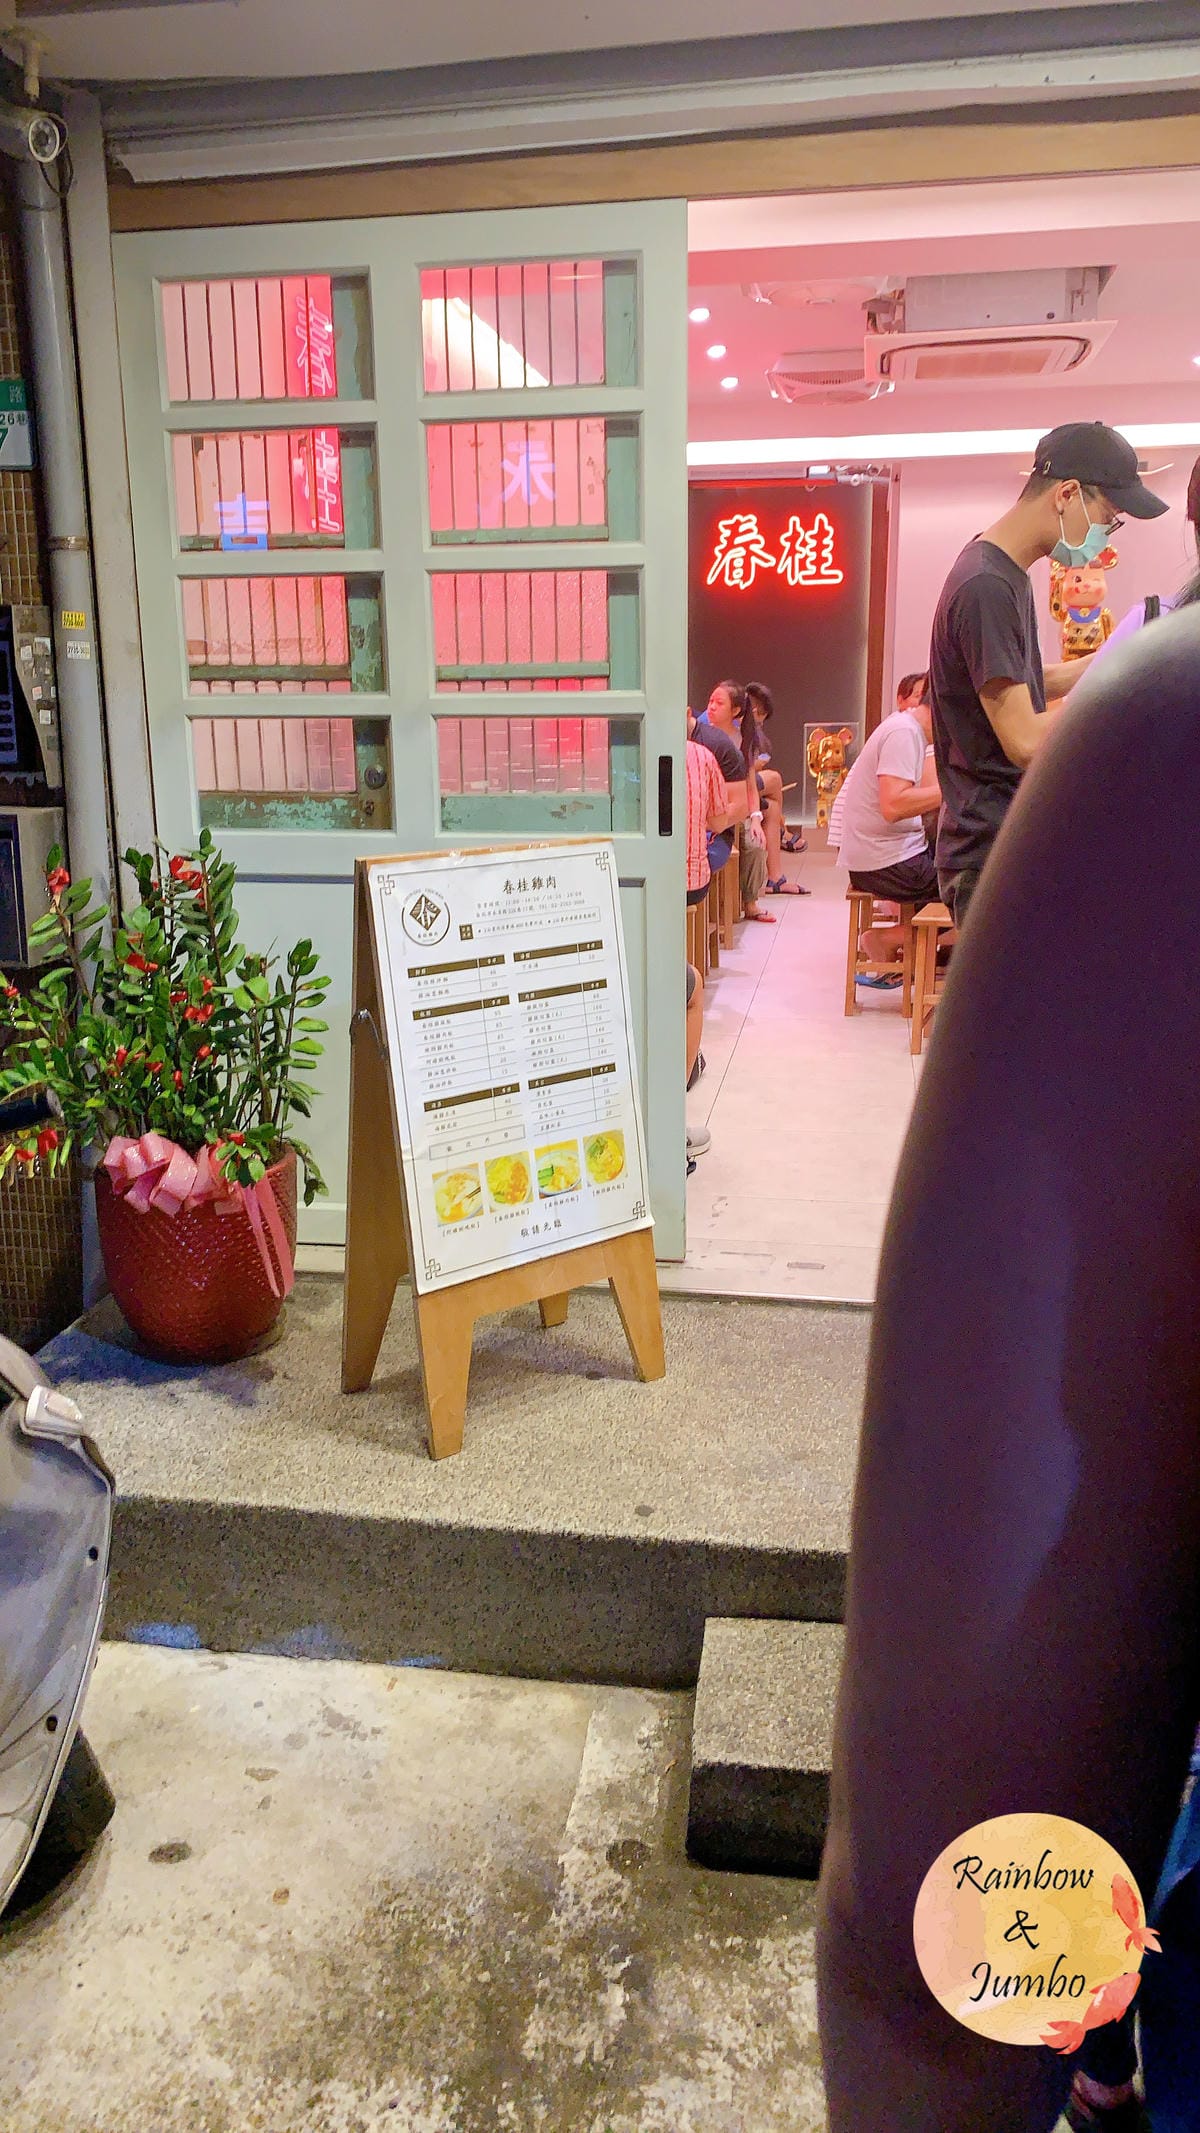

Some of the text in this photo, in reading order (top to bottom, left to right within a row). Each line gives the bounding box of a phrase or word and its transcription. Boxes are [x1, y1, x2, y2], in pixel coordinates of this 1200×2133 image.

[706, 512, 843, 590] 春桂
[502, 874, 557, 895] 春桂雞肉
